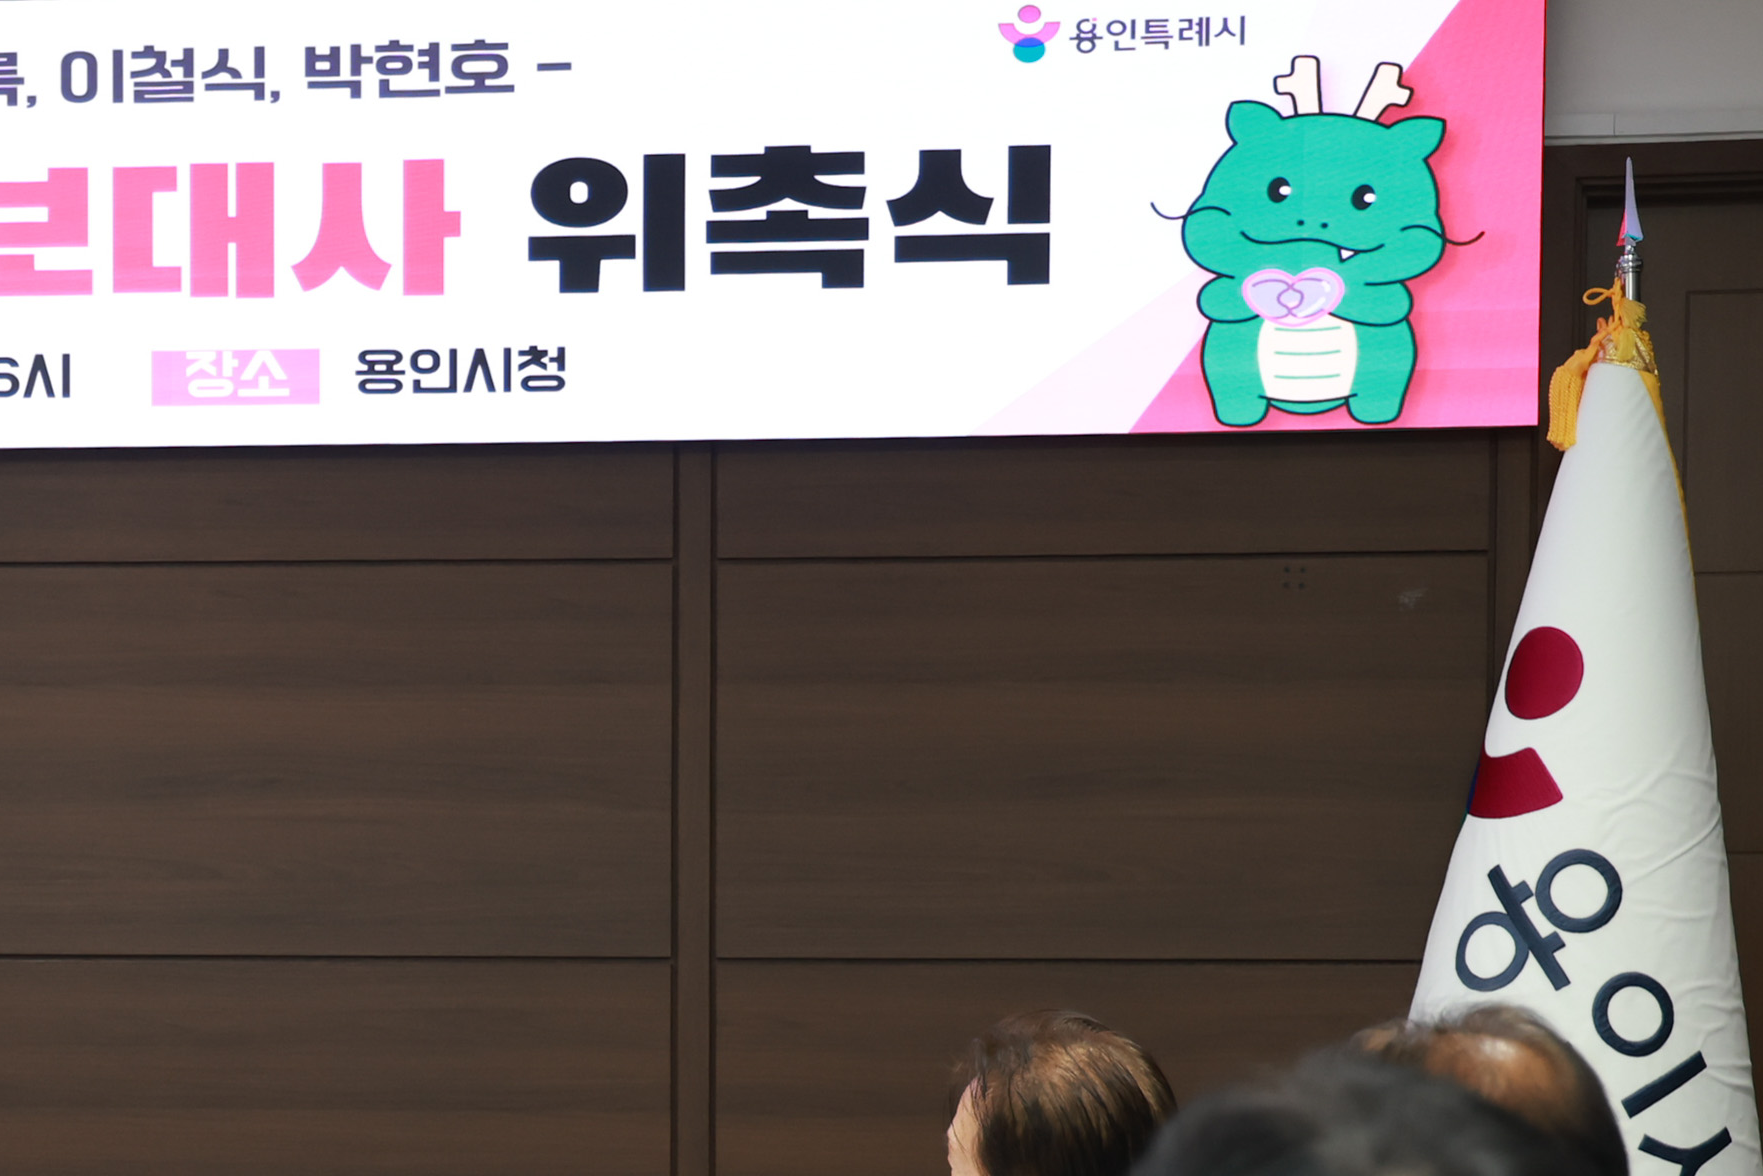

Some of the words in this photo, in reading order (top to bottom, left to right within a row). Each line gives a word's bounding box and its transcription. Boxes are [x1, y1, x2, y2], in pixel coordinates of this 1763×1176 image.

[1068, 15, 1246, 54] 용인특례시
[60, 44, 281, 104] 이철식,
[304, 39, 515, 99] 박현호
[527, 143, 1052, 294] 위촉식
[184, 349, 291, 398] 장소
[355, 345, 566, 395] 용인시청
